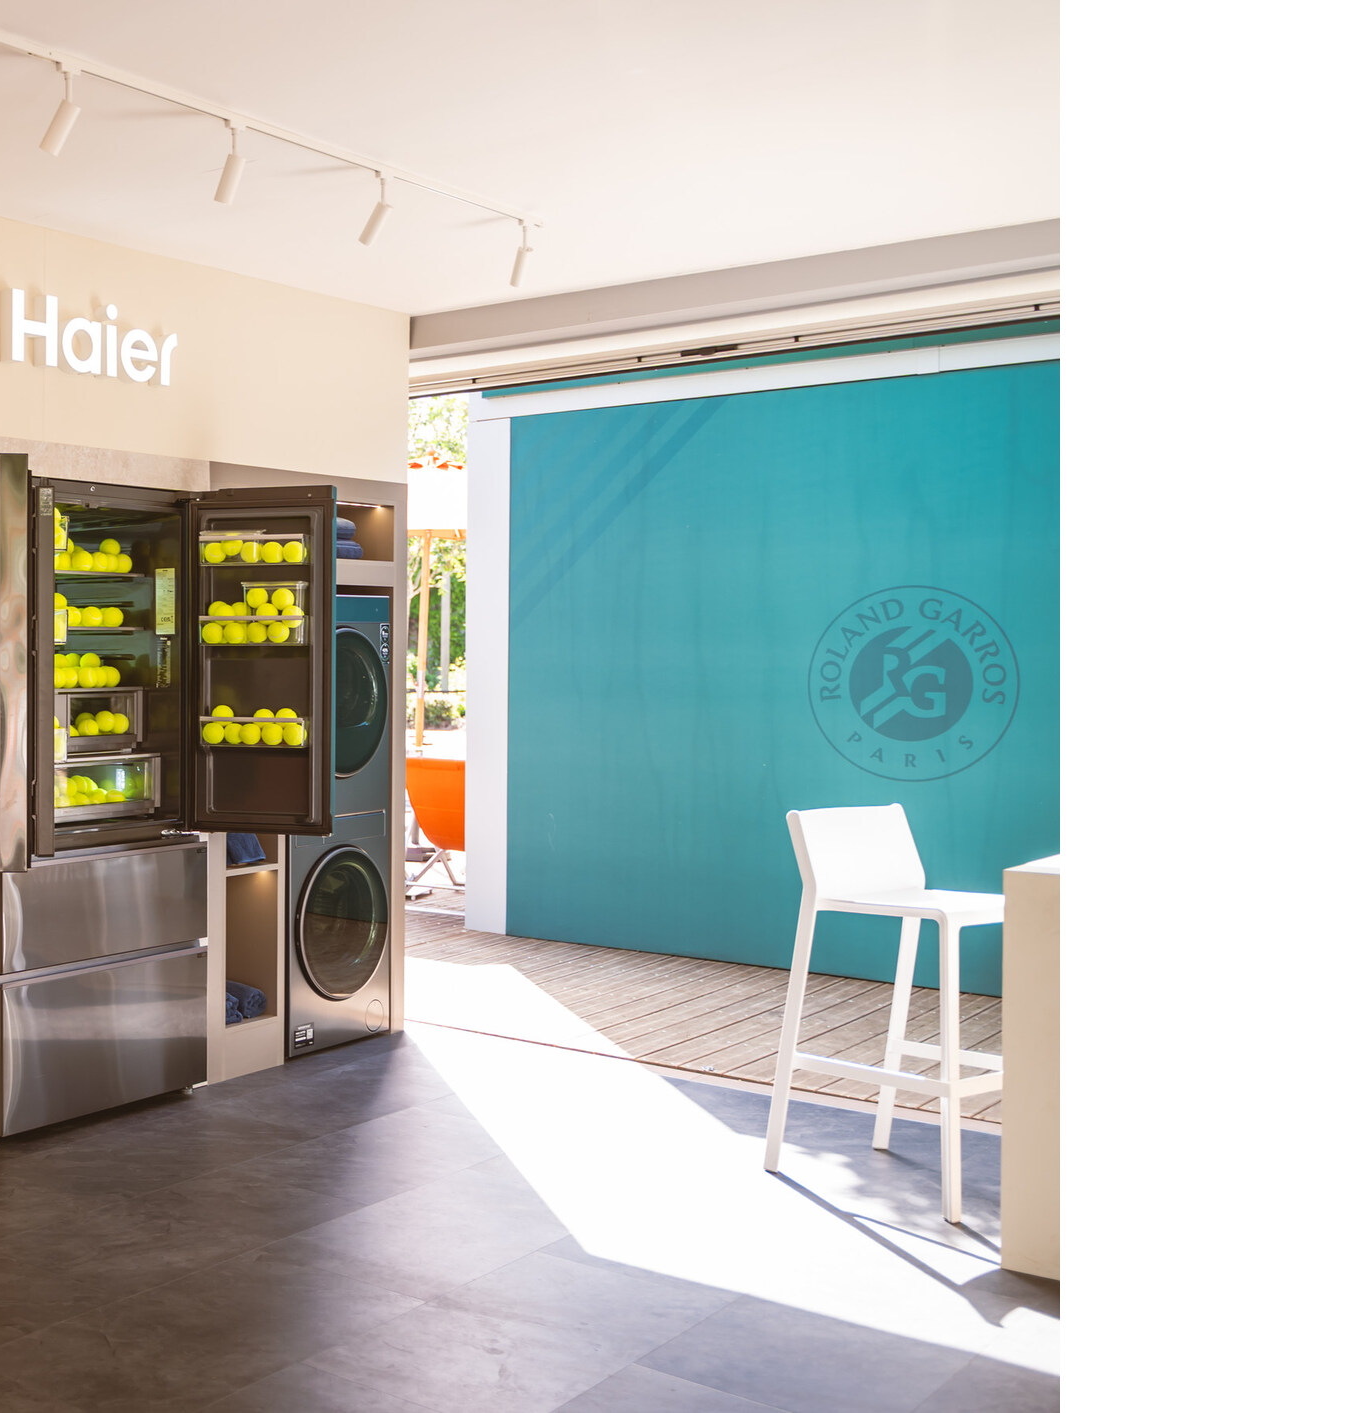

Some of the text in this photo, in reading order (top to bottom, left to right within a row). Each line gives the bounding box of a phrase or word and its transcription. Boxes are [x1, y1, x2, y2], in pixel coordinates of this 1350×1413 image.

[10, 287, 178, 386] Haier
[820, 598, 1007, 705] ROLAND GARROS
[846, 731, 974, 768] PARIS
